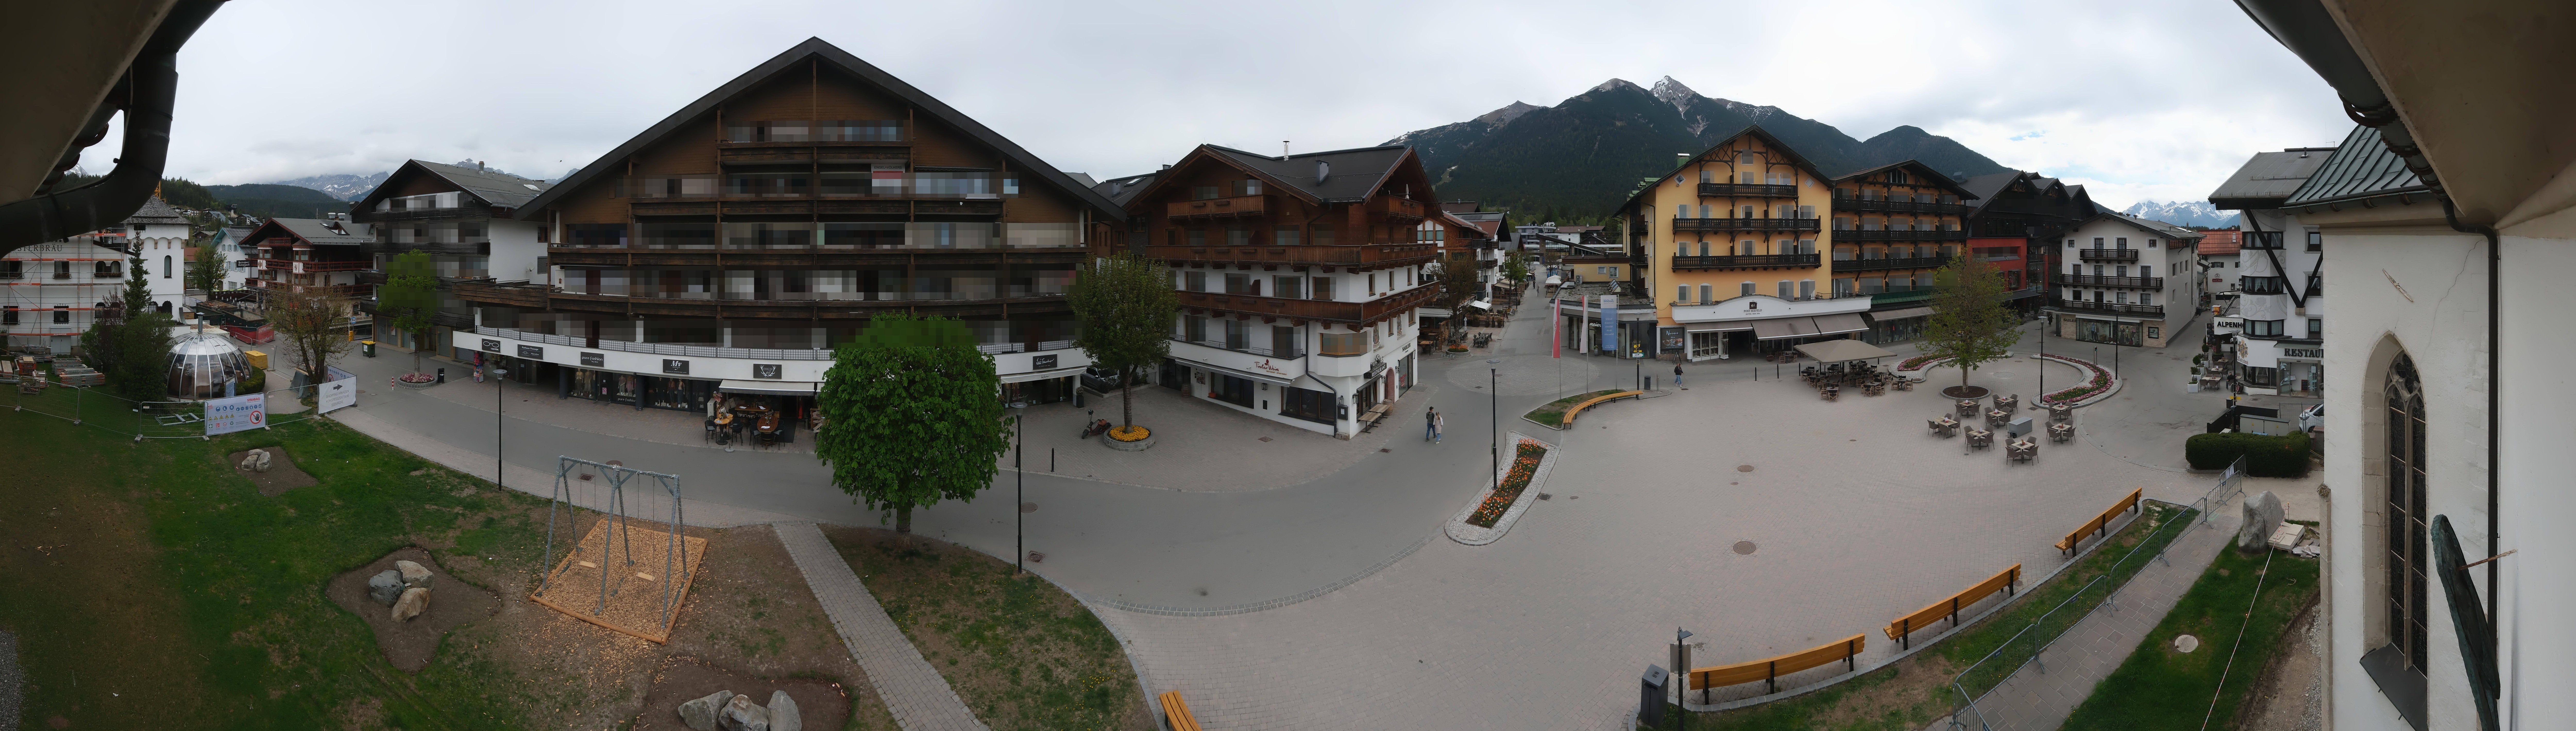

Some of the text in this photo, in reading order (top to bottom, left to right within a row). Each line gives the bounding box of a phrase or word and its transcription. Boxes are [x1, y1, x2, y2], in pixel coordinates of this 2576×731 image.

[1402, 343, 1411, 352] SAILER
[671, 361, 682, 370] My
[1372, 364, 1386, 377] RESTAURANT
[326, 395, 349, 403] KONGRESSZENTRUM
